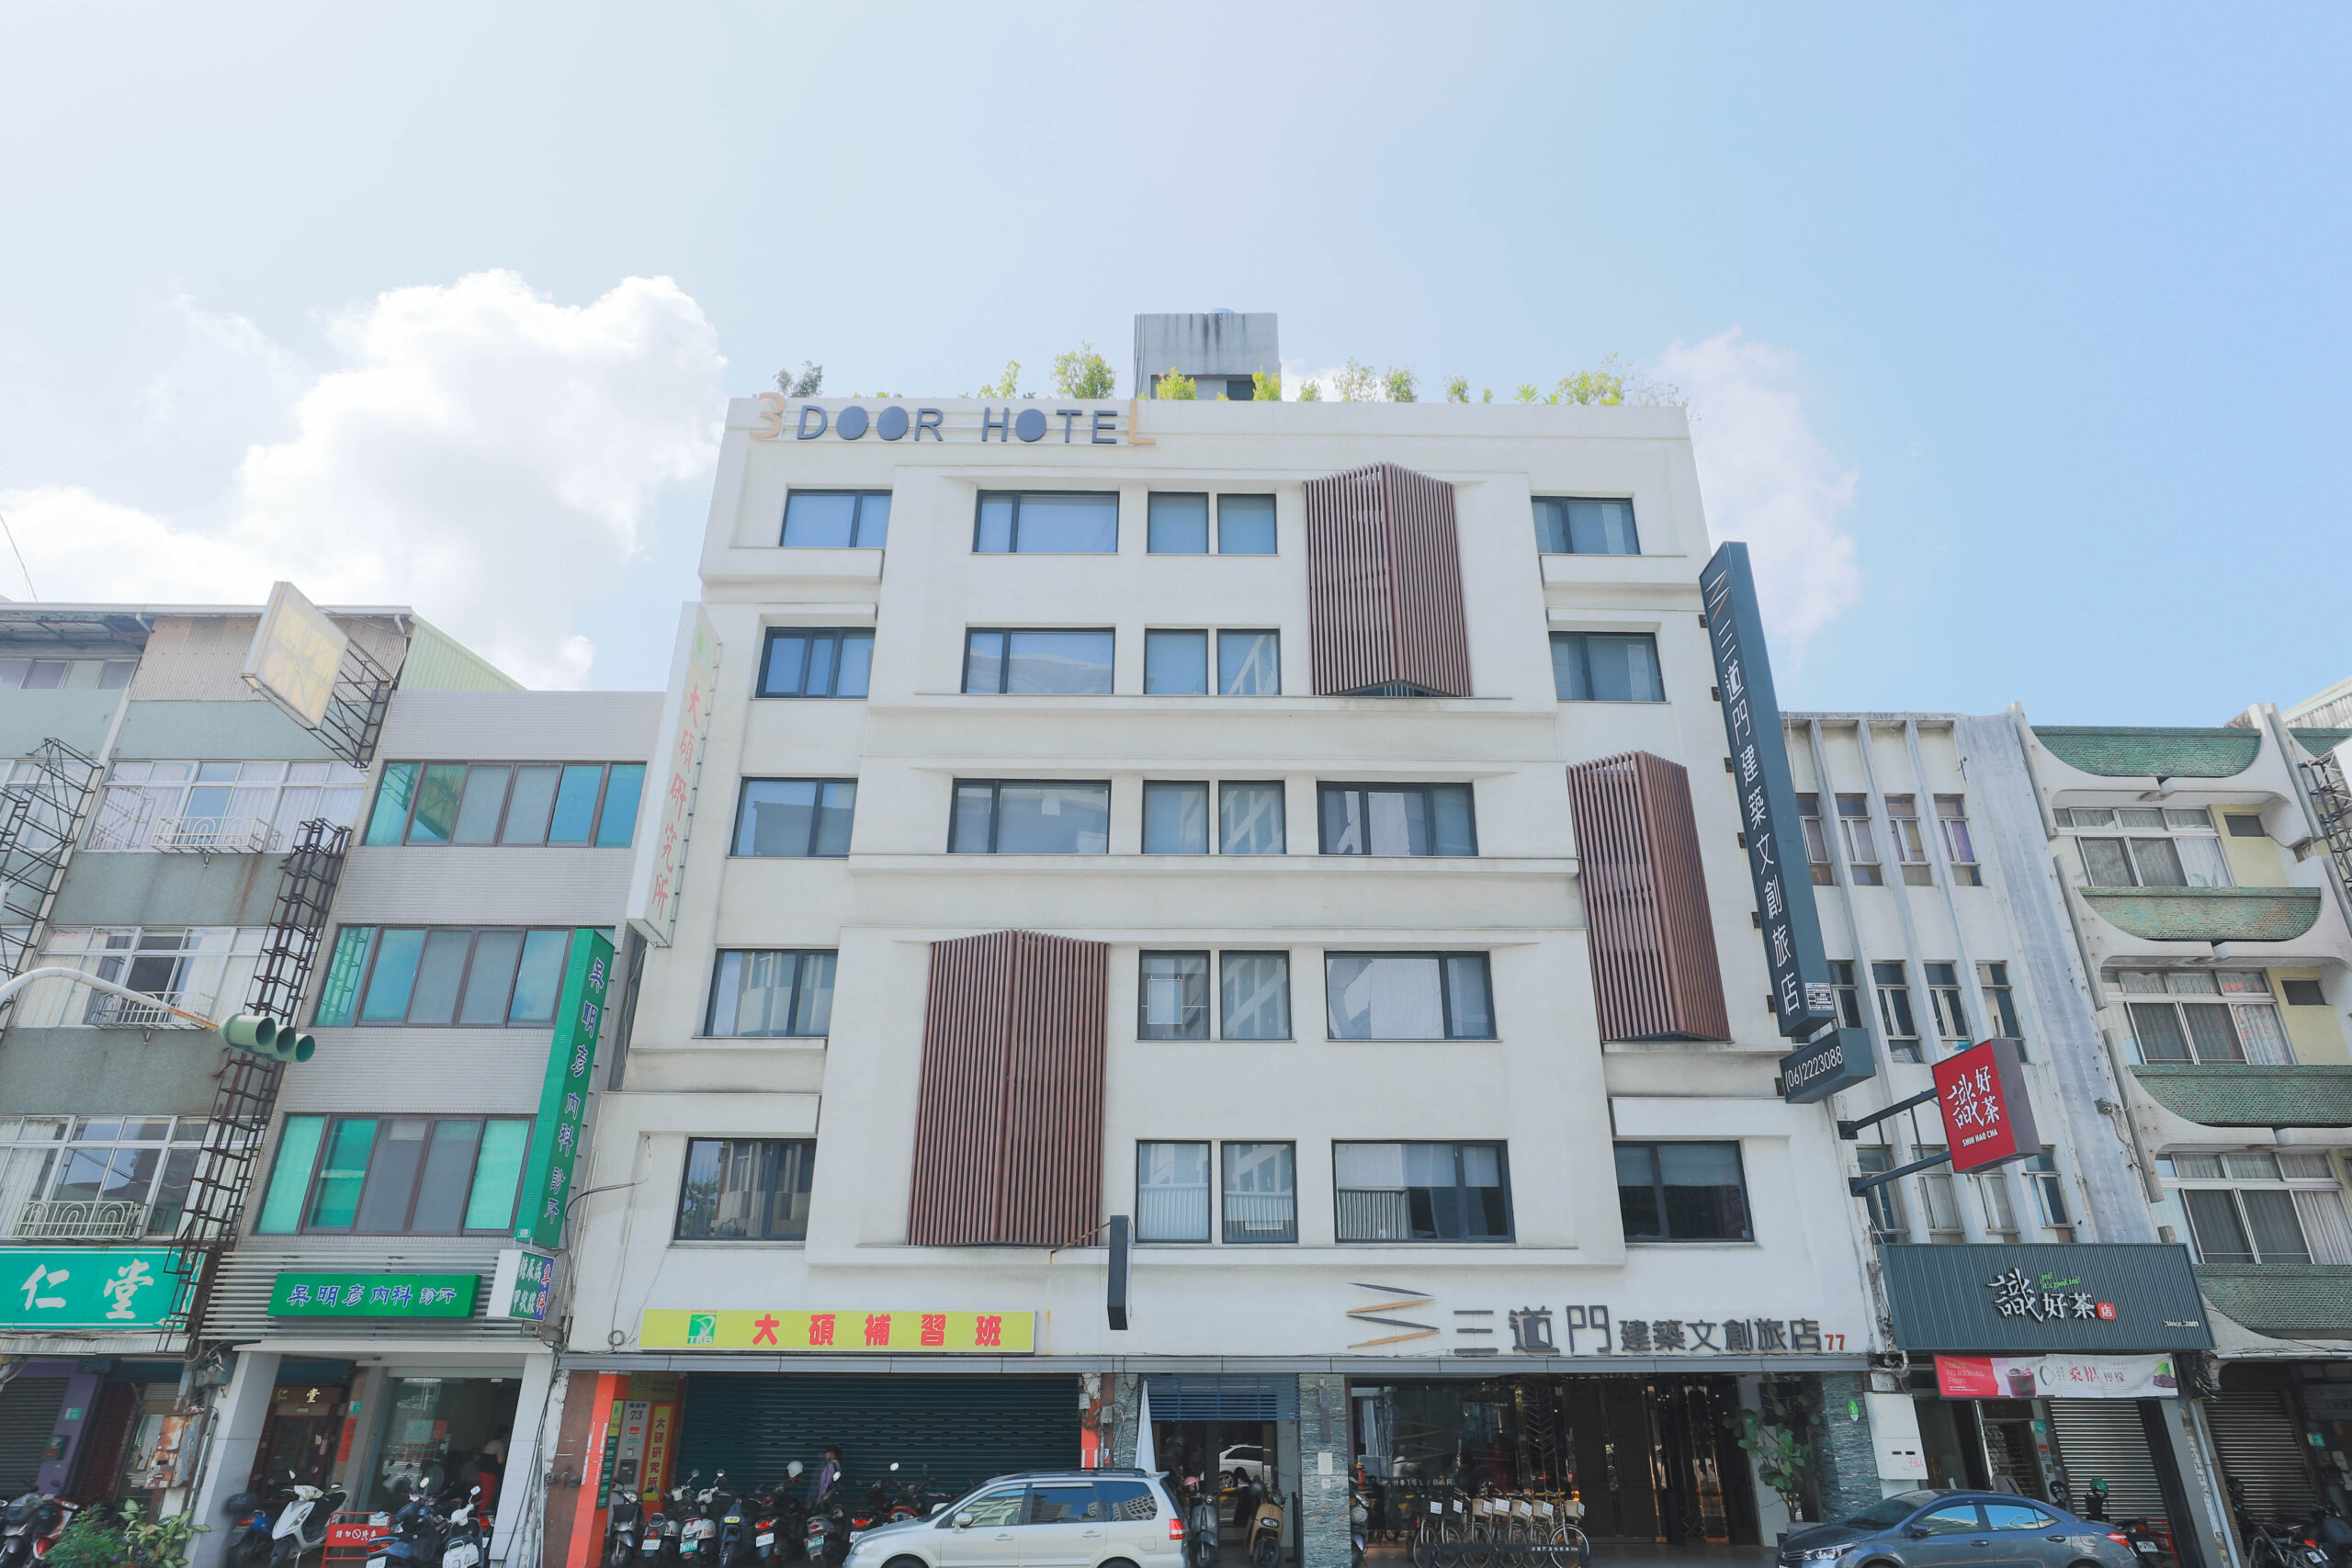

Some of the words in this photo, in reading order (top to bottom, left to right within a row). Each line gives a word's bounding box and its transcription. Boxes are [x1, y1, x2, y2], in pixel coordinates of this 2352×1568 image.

[981, 399, 1157, 446] HOTEL
[651, 680, 701, 920] 大碩研究所
[1718, 619, 1801, 1016] 三道門建築文創旅店
[1784, 1045, 1843, 1093] (06)2223088
[1962, 1134, 1975, 1147] SHIH
[1975, 1132, 1986, 1143] HAO
[1986, 1128, 1998, 1139] CHA
[20, 1258, 154, 1320] 仁堂
[687, 1336, 714, 1345] TKB
[752, 1314, 1002, 1347] 大碩補習班
[1824, 1334, 1846, 1351] 77
[630, 1410, 643, 1421] 73
